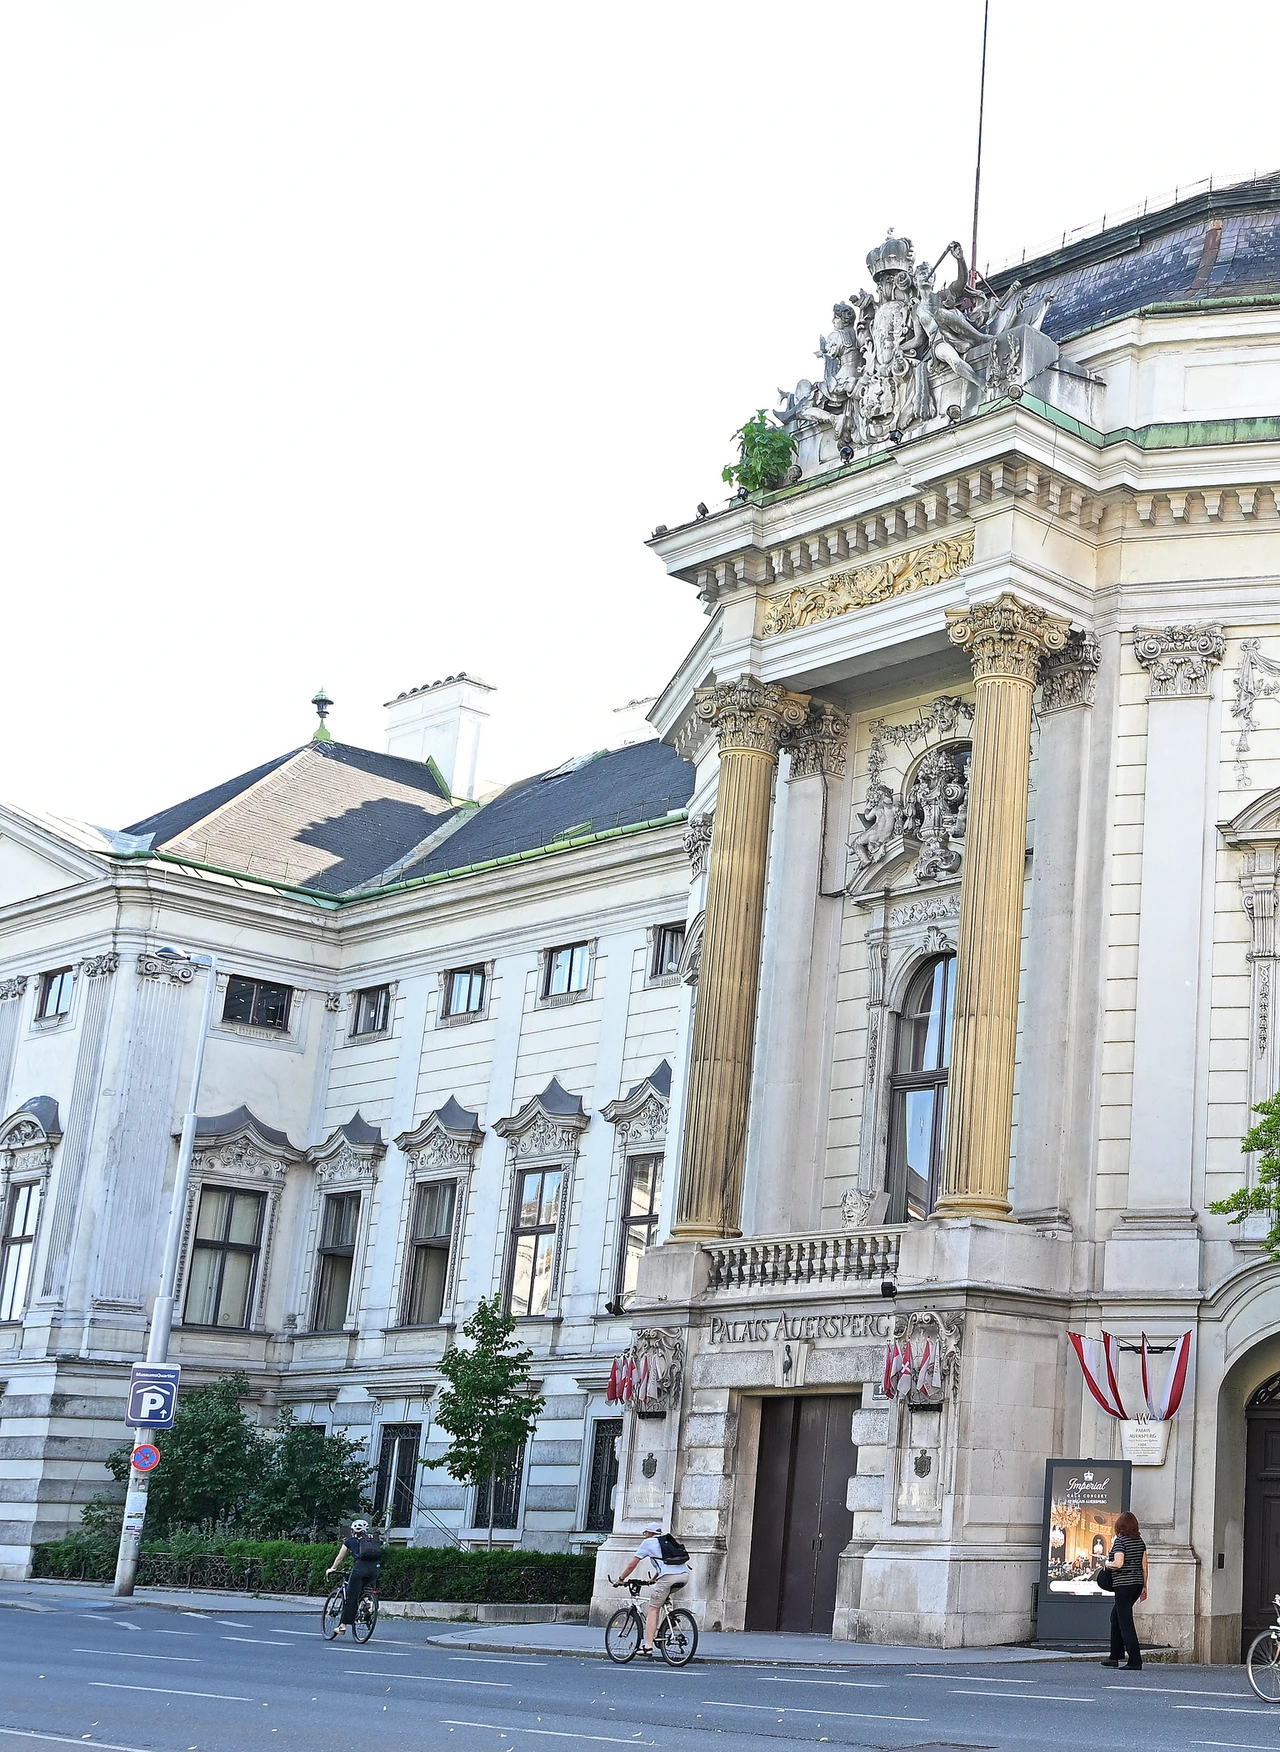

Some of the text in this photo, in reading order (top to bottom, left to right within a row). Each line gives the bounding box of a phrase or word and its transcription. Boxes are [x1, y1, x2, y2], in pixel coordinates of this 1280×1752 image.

[708, 1311, 890, 1345] PALAIS AUERSPERG
[140, 1393, 164, 1417] P
[1066, 1477, 1111, 1494] Imperial
